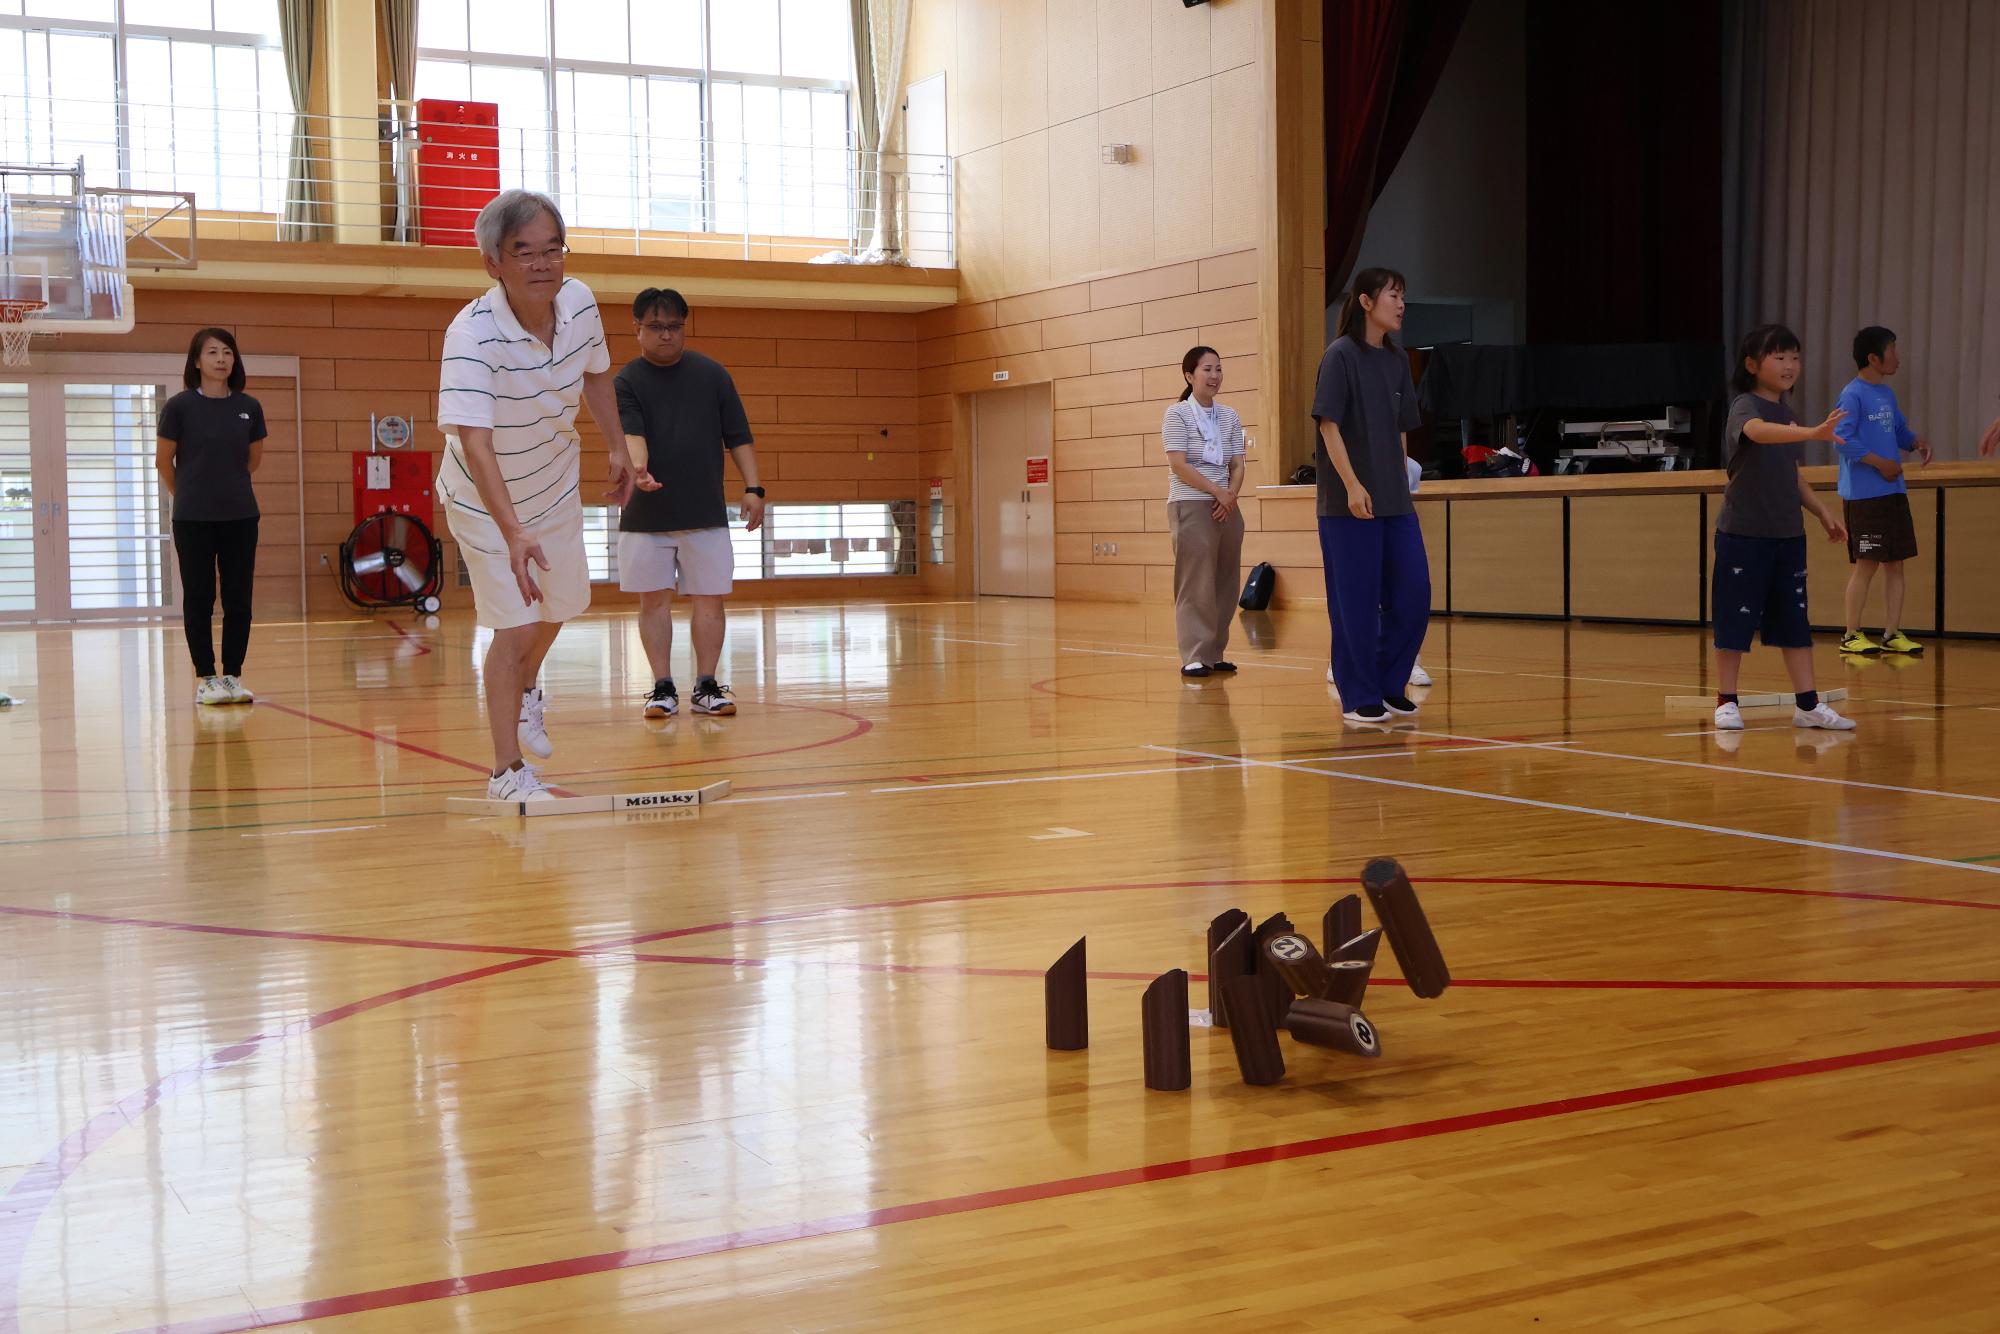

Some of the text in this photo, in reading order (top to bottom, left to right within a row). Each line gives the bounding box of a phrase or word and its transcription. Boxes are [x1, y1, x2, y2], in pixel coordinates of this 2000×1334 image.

[446, 151, 478, 161] 消火栓
[626, 794, 694, 807] Mölkky
[1274, 938, 1304, 958] 12
[1356, 1022, 1372, 1045] 8
